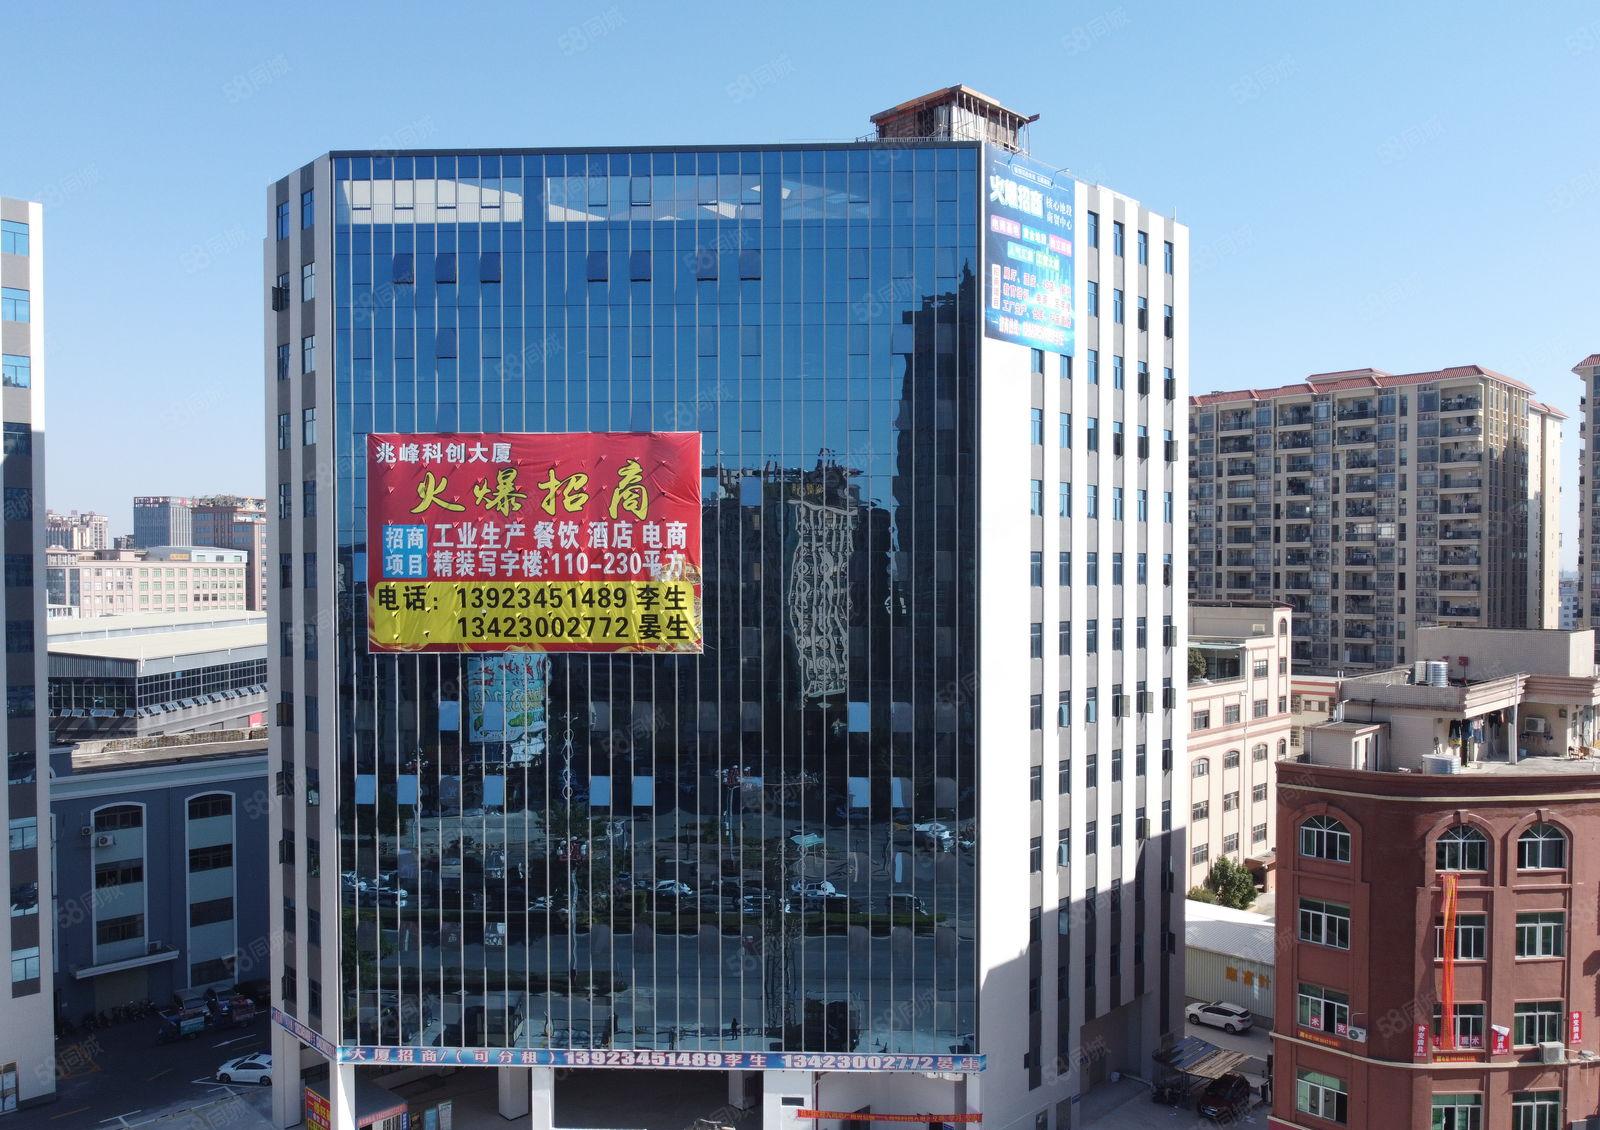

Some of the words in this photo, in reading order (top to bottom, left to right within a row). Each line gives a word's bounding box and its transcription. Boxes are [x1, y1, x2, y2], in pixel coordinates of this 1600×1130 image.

[376, 442, 512, 464] 兆峰科创大厦
[410, 459, 649, 521] 火爆招商
[385, 526, 425, 549] 招商
[433, 523, 526, 549] 工业生产
[533, 521, 580, 549] 餐饮
[587, 521, 633, 549] 酒店
[642, 521, 688, 550] 电商
[385, 553, 424, 576] 项目
[457, 588, 628, 609] 13923451489
[636, 587, 688, 611] 李生
[458, 616, 630, 638] 13423002772
[638, 614, 690, 640] 晏生
[564, 1051, 722, 1067] 13923451489
[782, 1054, 933, 1070] 13423002772
